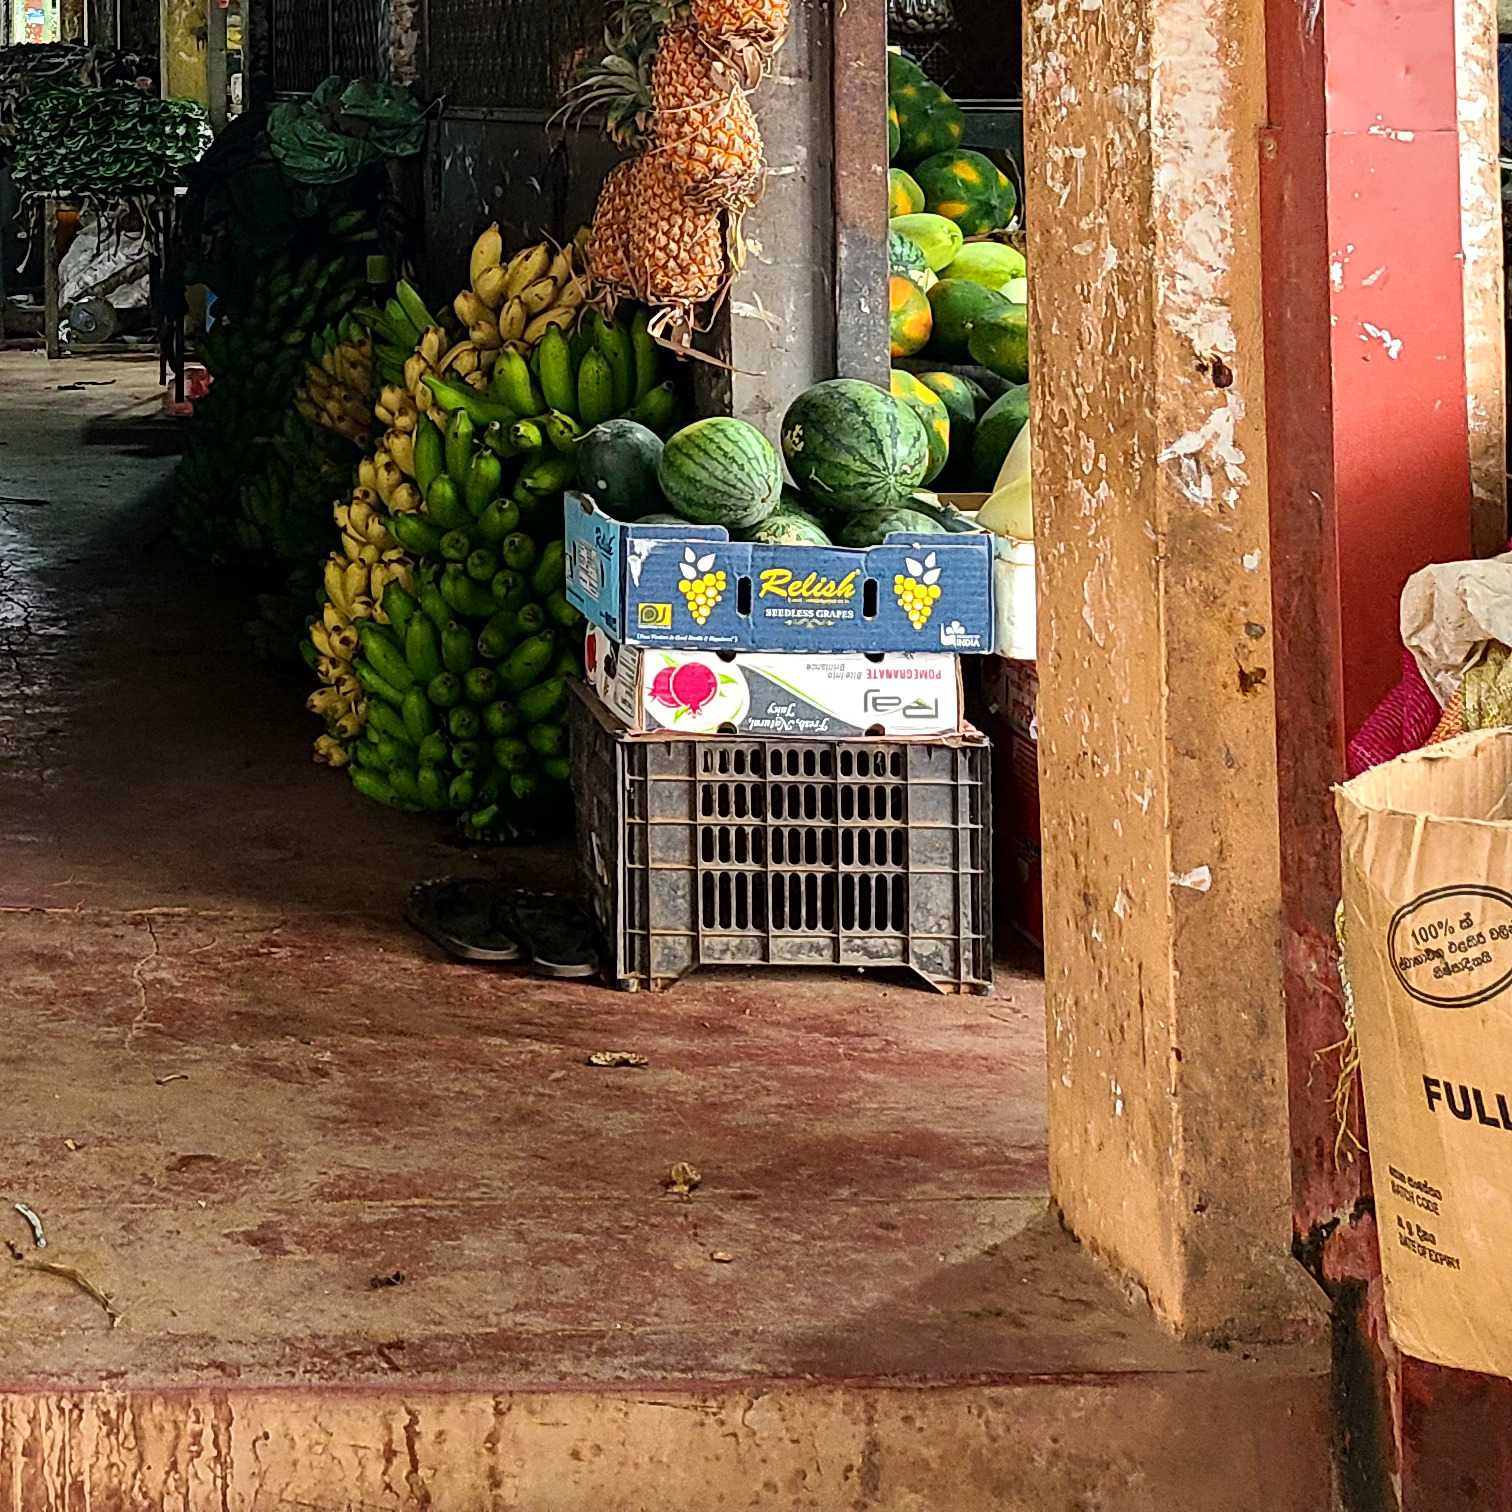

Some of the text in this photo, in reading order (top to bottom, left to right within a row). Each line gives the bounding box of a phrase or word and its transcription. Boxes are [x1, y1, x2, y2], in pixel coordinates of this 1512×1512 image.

[759, 568, 856, 598] Relish
[765, 608, 855, 619] SEEDLESS GRAPES
[956, 638, 981, 648] INDIA
[866, 669, 941, 680] POMEGRANATE
[766, 701, 797, 718] Juicy
[864, 688, 939, 719] Raj
[1411, 917, 1455, 945] 100%
[1422, 1073, 1512, 1131] FULL
